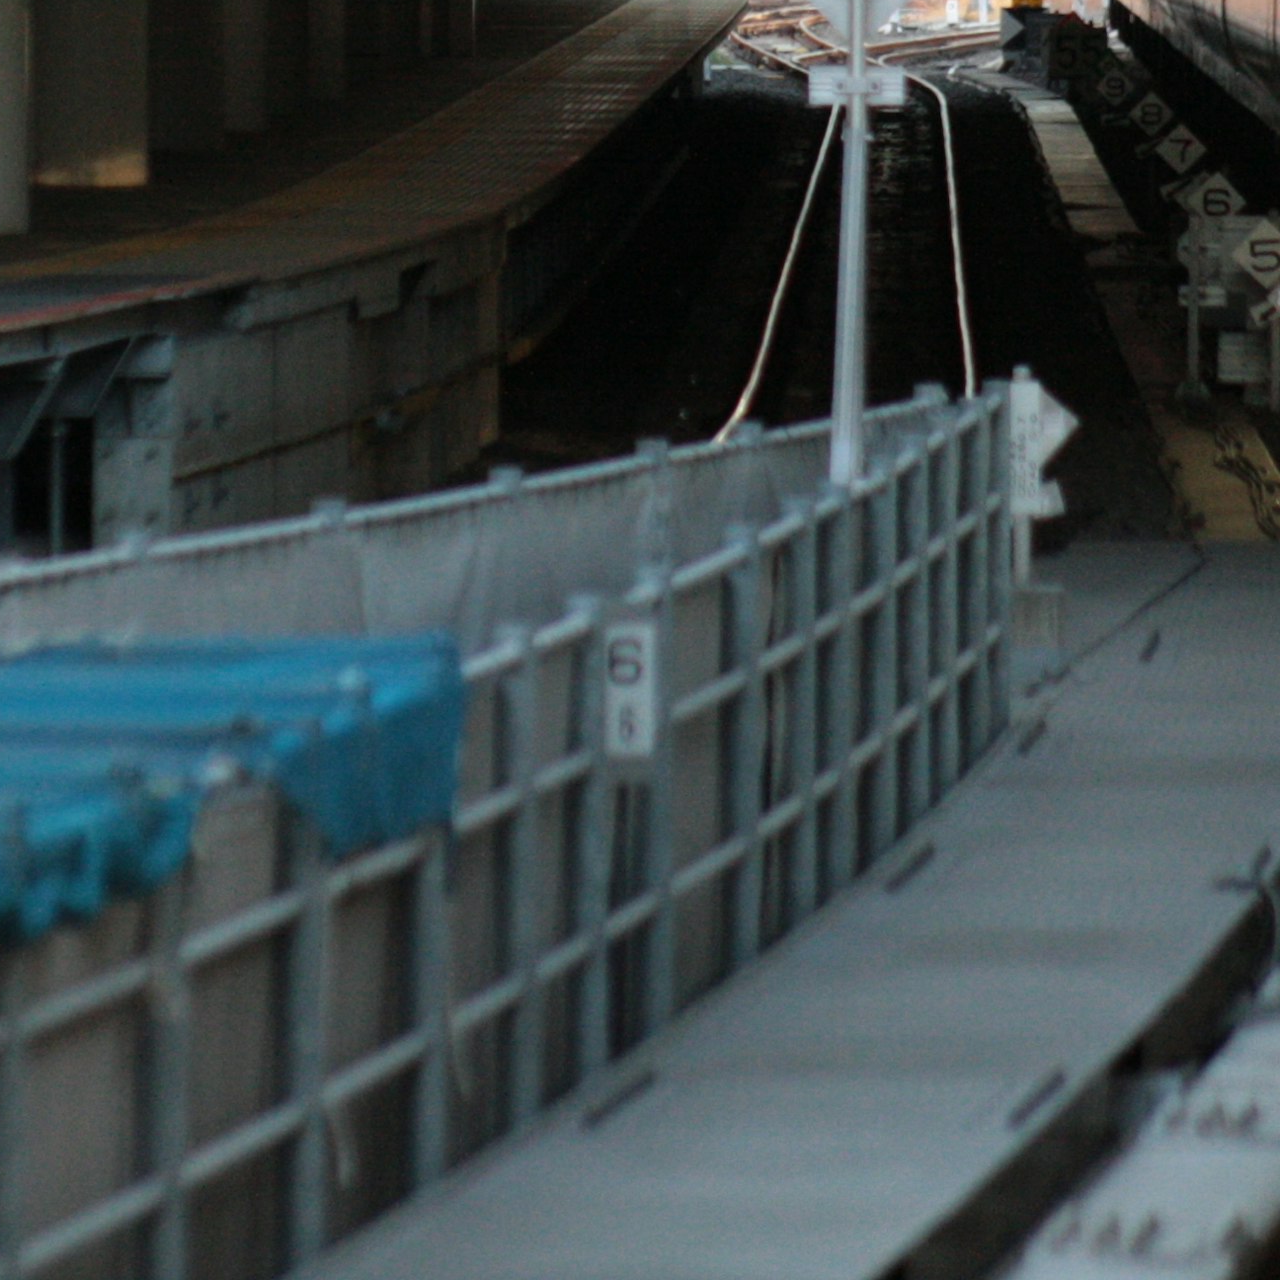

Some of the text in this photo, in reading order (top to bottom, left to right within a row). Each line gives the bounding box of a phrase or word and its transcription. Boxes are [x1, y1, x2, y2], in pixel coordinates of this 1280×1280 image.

[1105, 76, 1125, 98] 9
[1141, 103, 1162, 125] 8
[1169, 138, 1194, 163] 7
[1203, 188, 1231, 216] 6
[608, 638, 643, 686] 6
